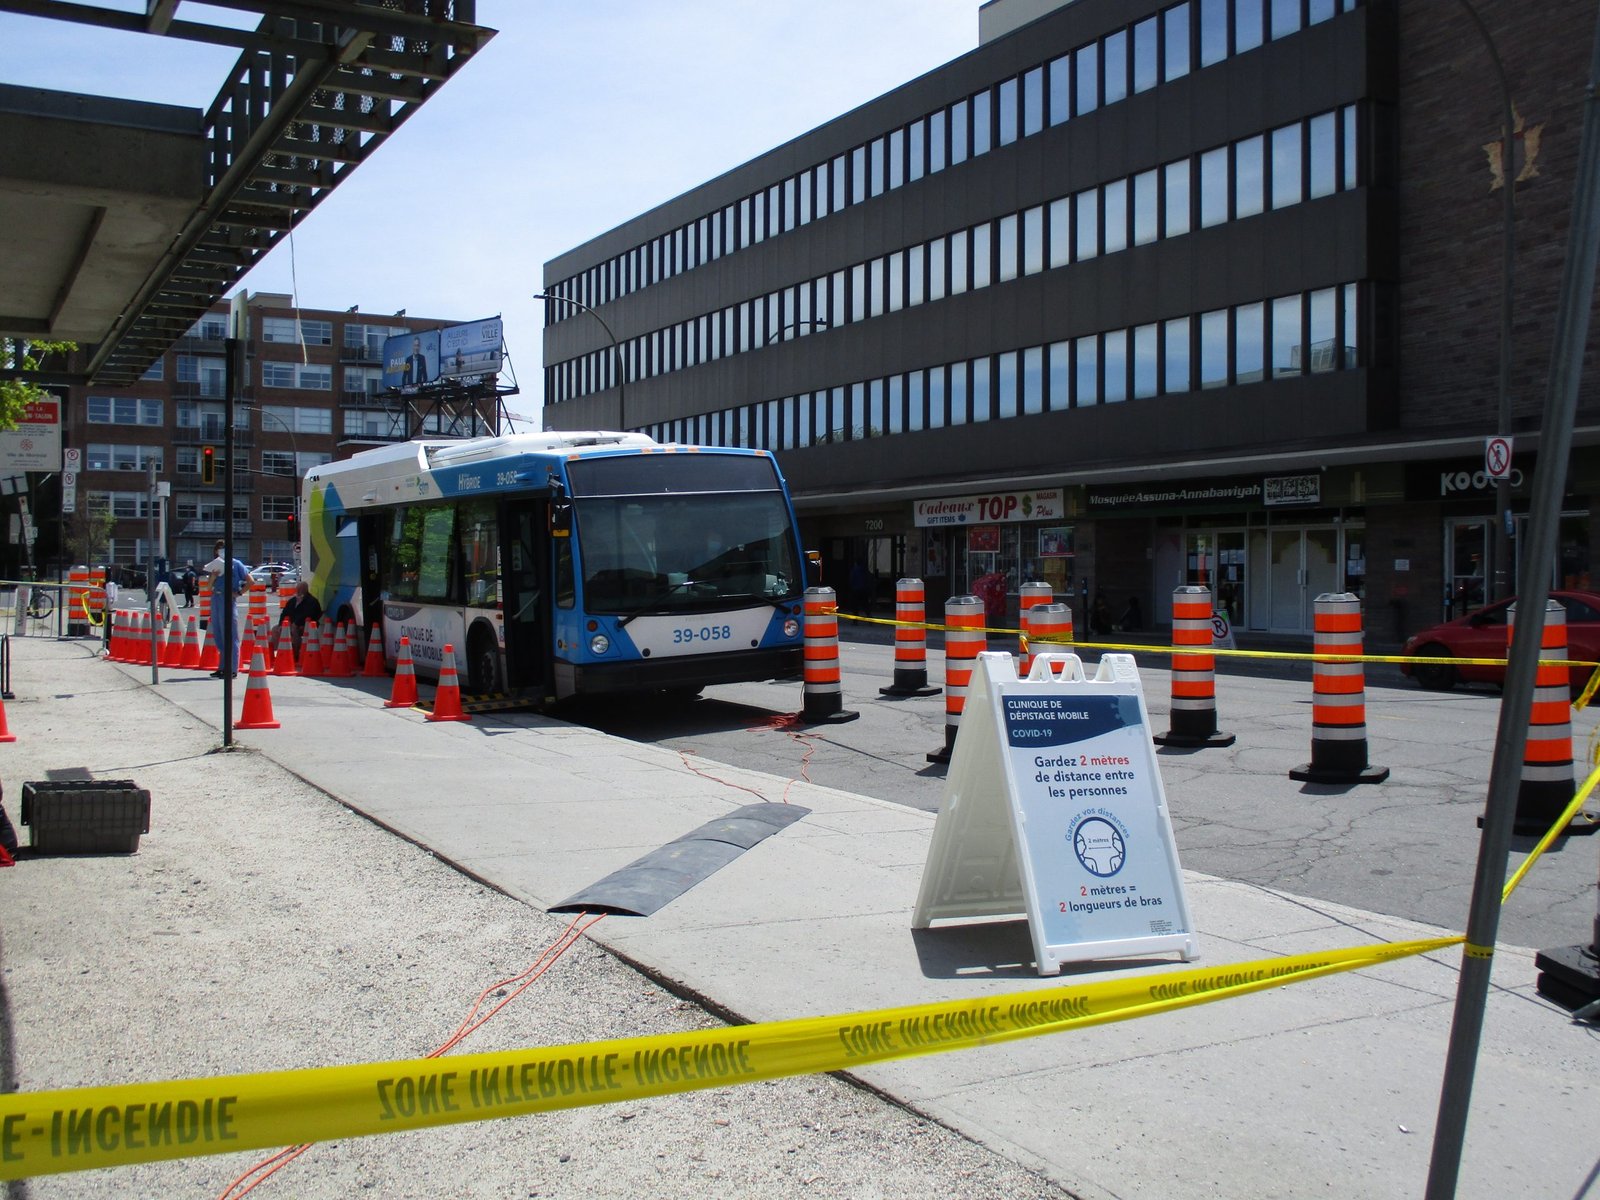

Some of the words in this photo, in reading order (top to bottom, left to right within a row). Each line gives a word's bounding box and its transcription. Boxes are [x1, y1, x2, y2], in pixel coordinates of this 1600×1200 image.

[482, 328, 498, 339] VILLE
[496, 470, 518, 486] 39-058
[1036, 492, 1058, 500] MAGASIN
[918, 500, 975, 516] Cadeaux
[977, 495, 1018, 521] TOP
[1036, 505, 1054, 517] Plus
[864, 519, 884, 530] 7200
[927, 516, 939, 525] GIFT
[939, 515, 956, 524] ITEMS
[401, 625, 425, 641] CLINIQUE
[426, 629, 433, 642] DE
[673, 625, 731, 643] 39-058
[422, 645, 443, 661] MOBILE
[1008, 700, 1049, 709] CLINIQUE
[1050, 700, 1062, 708] DE
[1010, 710, 1056, 720] DÉPISTAGE
[1058, 711, 1090, 720] MOBILE
[1012, 729, 1052, 738] COVID-19
[1034, 755, 1077, 767] Gardez
[1079, 755, 1087, 766] 2
[1091, 754, 1130, 766] mètres
[1035, 771, 1050, 783] de
[1053, 770, 1101, 782] distance
[1105, 770, 1134, 780] entre
[1048, 786, 1065, 797] les
[1069, 786, 1127, 800] personnes
[1065, 813, 1082, 842] Gardez
[1082, 807, 1096, 816] vos
[1097, 807, 1130, 839] distances
[1080, 885, 1087, 896] 2
[1090, 884, 1127, 896] mètres
[1059, 902, 1067, 912] 2
[1069, 900, 1122, 914] longueurs
[1124, 896, 1137, 907] de
[1139, 895, 1163, 906] bras
